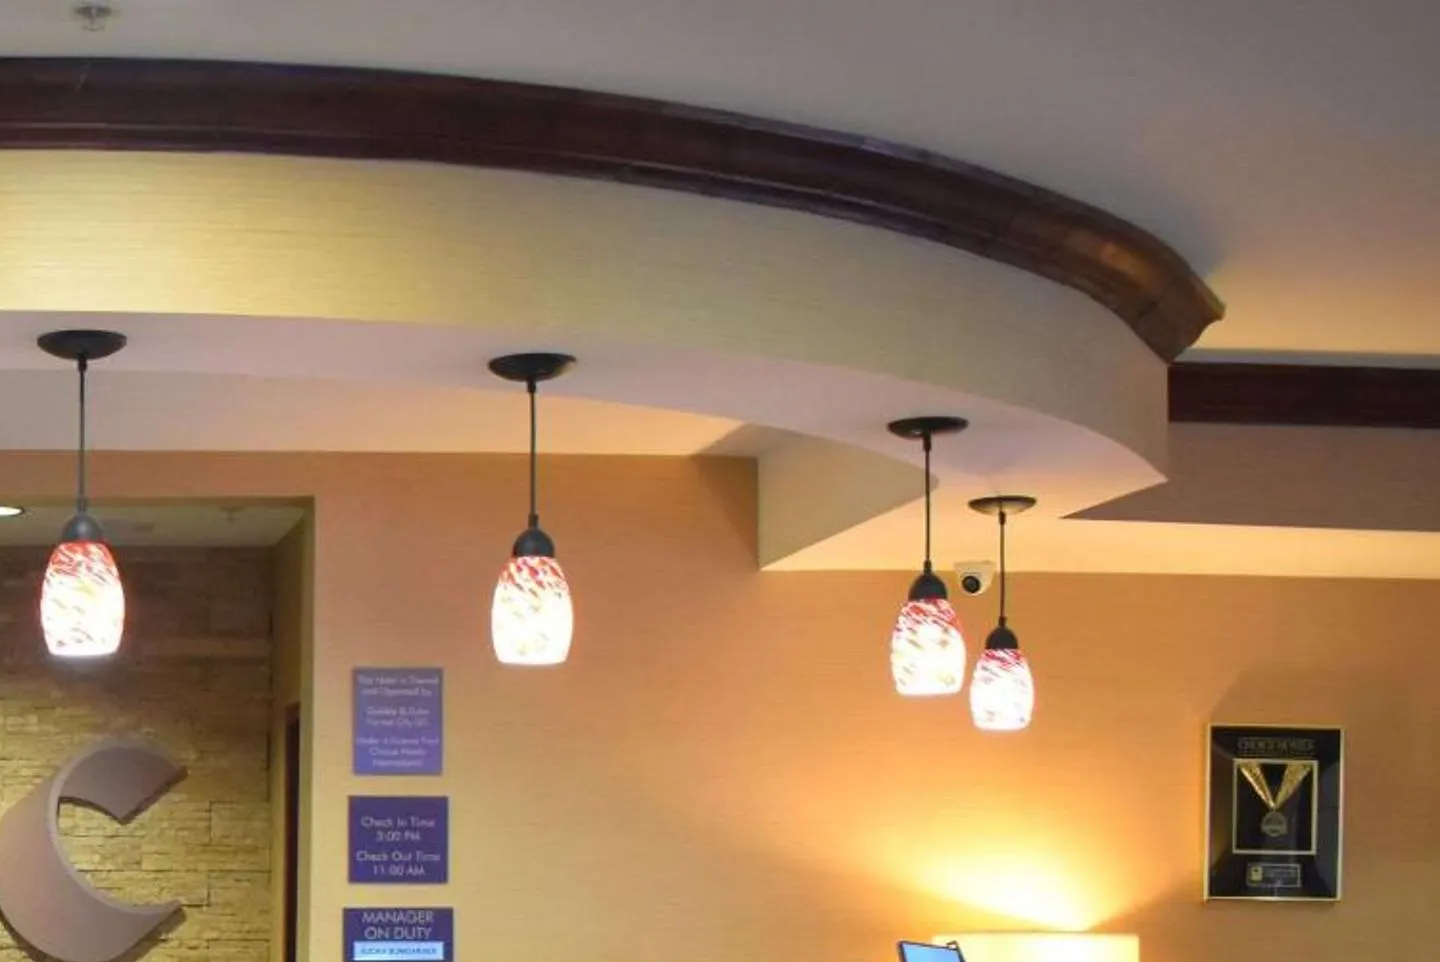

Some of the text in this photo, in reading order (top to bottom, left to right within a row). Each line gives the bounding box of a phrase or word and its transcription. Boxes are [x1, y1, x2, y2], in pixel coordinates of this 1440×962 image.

[360, 816, 436, 828] Check In Time
[404, 830, 422, 842] PM
[356, 850, 441, 862] Check Out Time
[406, 864, 426, 876] AM
[362, 911, 434, 925] MANAGER
[364, 926, 433, 940] ON DUTY
